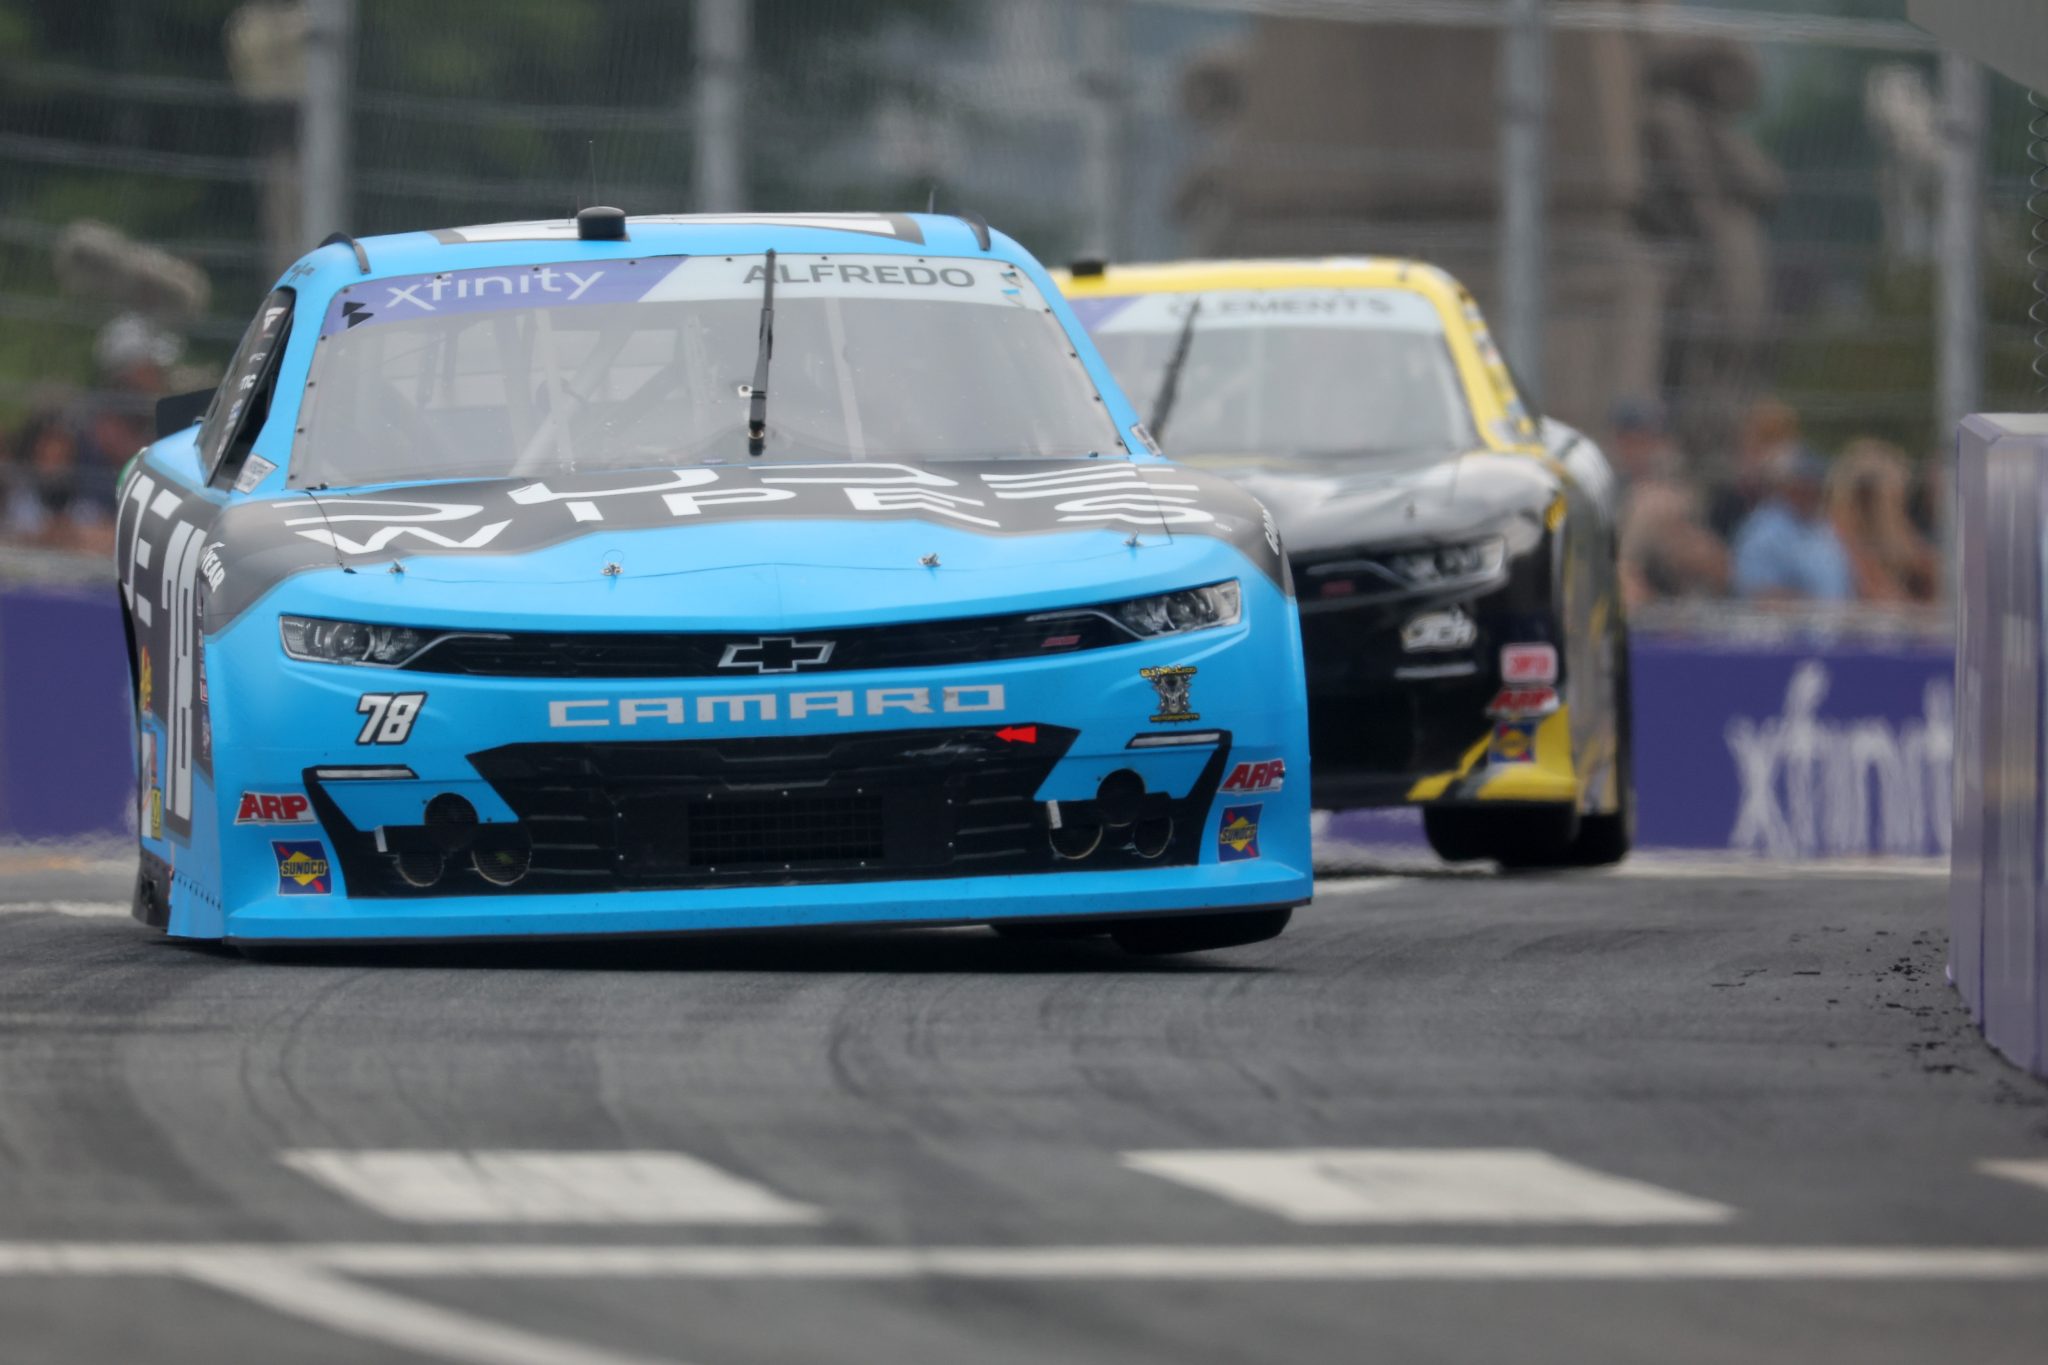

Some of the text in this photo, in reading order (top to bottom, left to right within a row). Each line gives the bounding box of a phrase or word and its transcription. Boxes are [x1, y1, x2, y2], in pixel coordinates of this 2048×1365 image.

[386, 268, 605, 311] xfinity
[743, 264, 975, 288] ALFREDO
[1168, 298, 1392, 319] CEMENTS
[356, 691, 428, 746] 78
[549, 685, 1005, 728] CAMARO
[1223, 760, 1285, 790] ARP
[237, 793, 309, 820] ARP
[281, 861, 328, 876] SUNOCO
